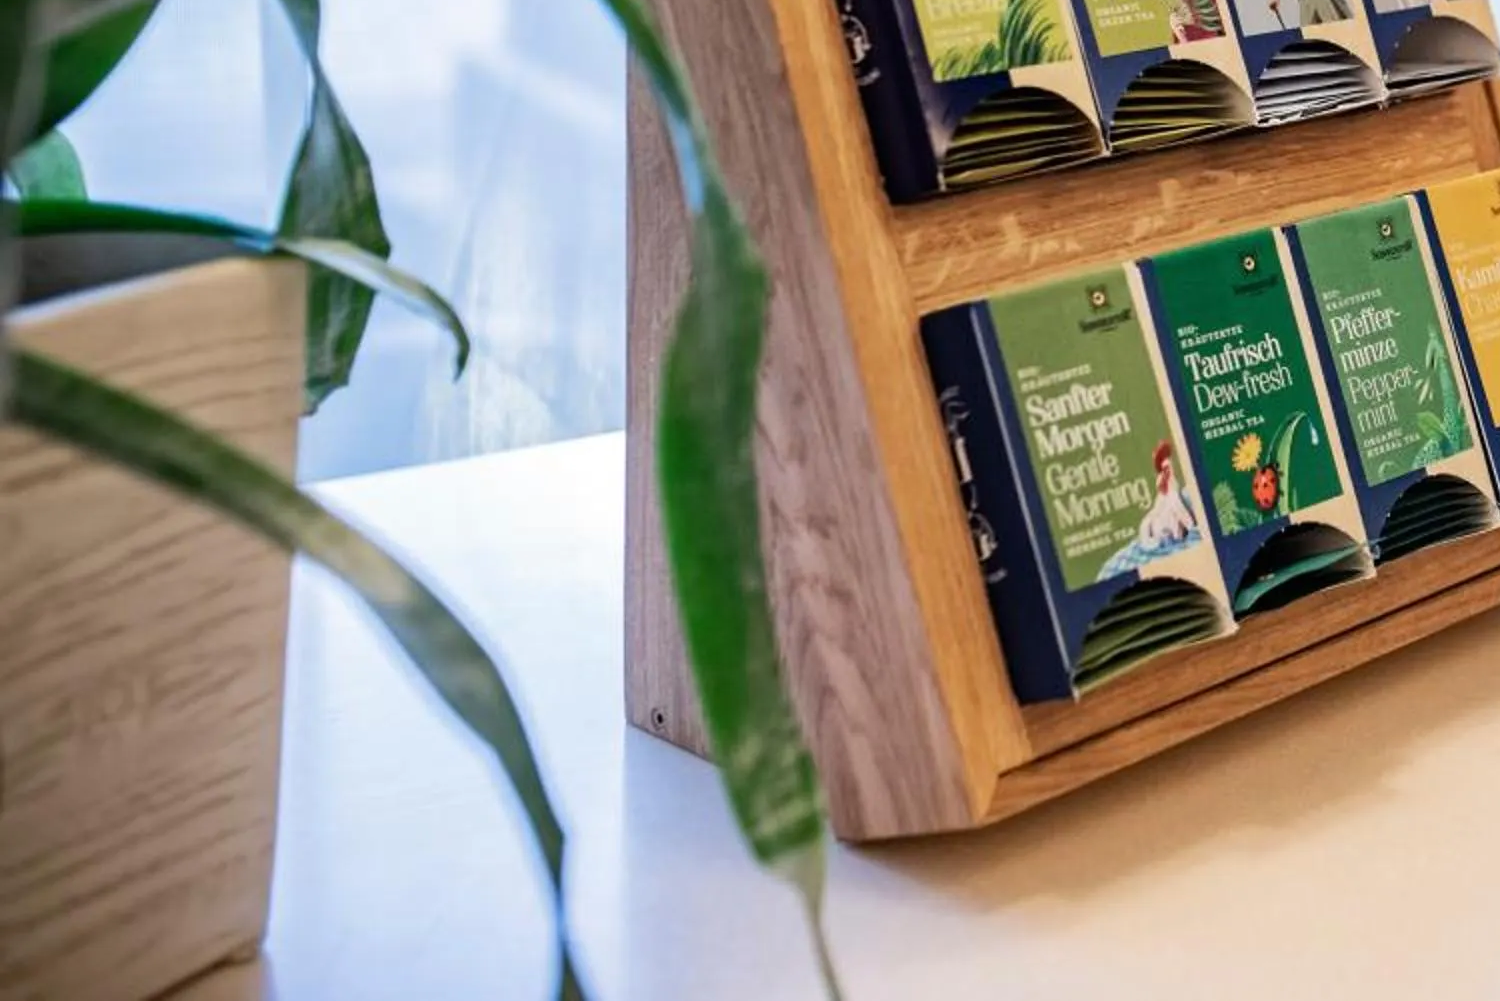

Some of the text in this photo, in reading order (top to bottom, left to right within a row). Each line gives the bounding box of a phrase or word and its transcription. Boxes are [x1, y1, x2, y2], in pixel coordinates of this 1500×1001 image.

[1329, 306, 1402, 344] Pfeffer-
[1183, 332, 1283, 382] Taufrisch
[1340, 337, 1399, 374] minze
[1026, 381, 1113, 427] Sanfter
[1192, 363, 1293, 413] Dew-fresh
[1348, 364, 1420, 404] Pepper-
[1034, 411, 1131, 460] Morgen
[1201, 409, 1245, 429] ORGANIC
[1246, 415, 1265, 430] TEA
[1357, 399, 1398, 433] mint
[1046, 451, 1120, 495] Gentle
[1054, 478, 1152, 529] Morning
